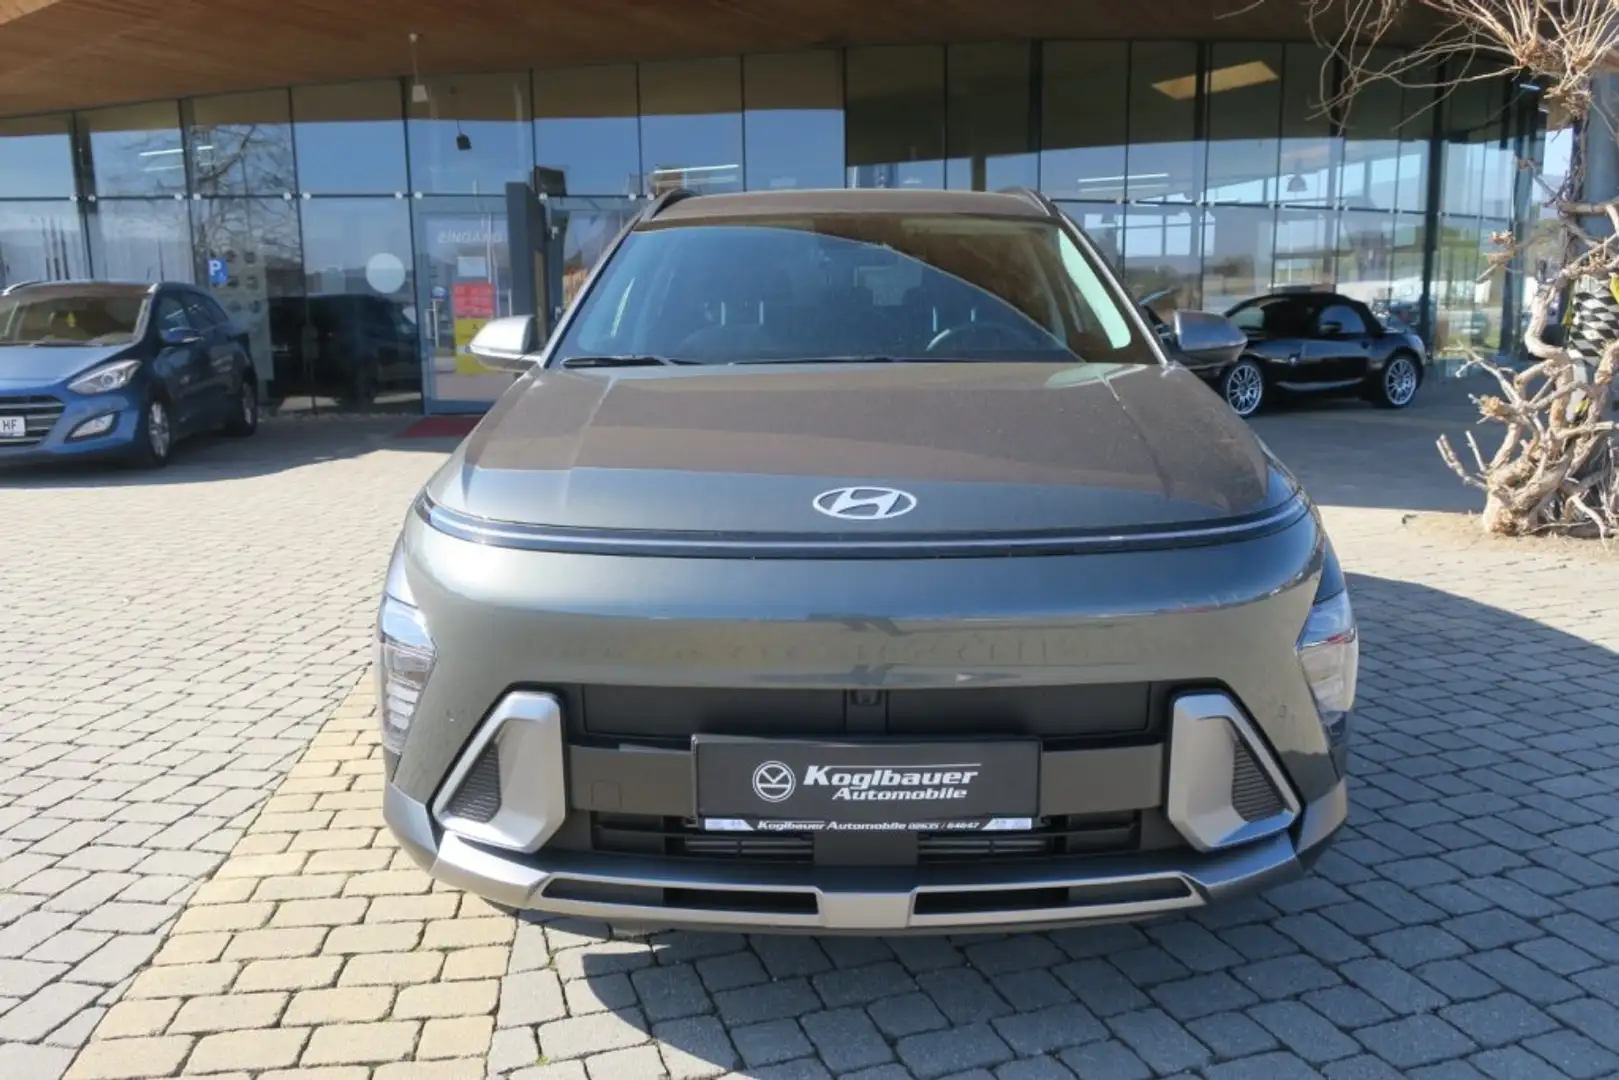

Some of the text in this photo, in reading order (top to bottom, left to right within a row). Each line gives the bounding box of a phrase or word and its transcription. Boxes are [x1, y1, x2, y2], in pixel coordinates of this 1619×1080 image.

[803, 766, 979, 789] Koglbauer
[832, 787, 968, 801] Automobile
[758, 820, 825, 831] Koglbauer
[827, 820, 906, 830] Automobile
